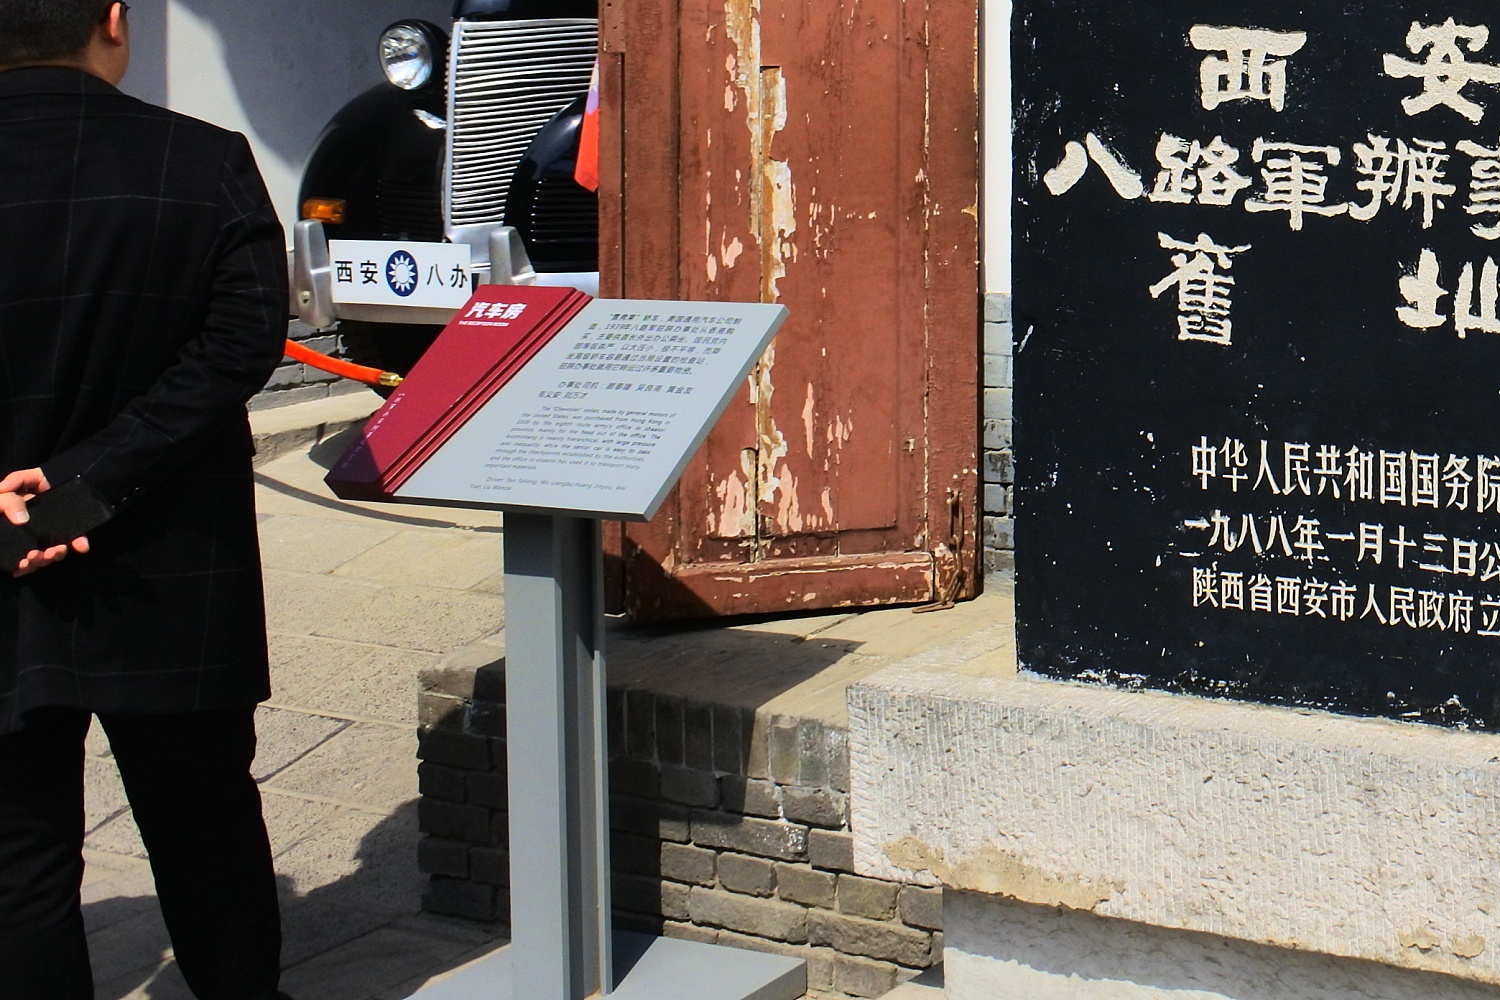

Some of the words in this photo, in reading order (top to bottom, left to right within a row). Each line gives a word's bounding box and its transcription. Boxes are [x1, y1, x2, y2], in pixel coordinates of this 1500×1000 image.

[335, 260, 378, 285] 西安
[426, 263, 468, 289] 八办
[464, 302, 527, 319] 汽车房
